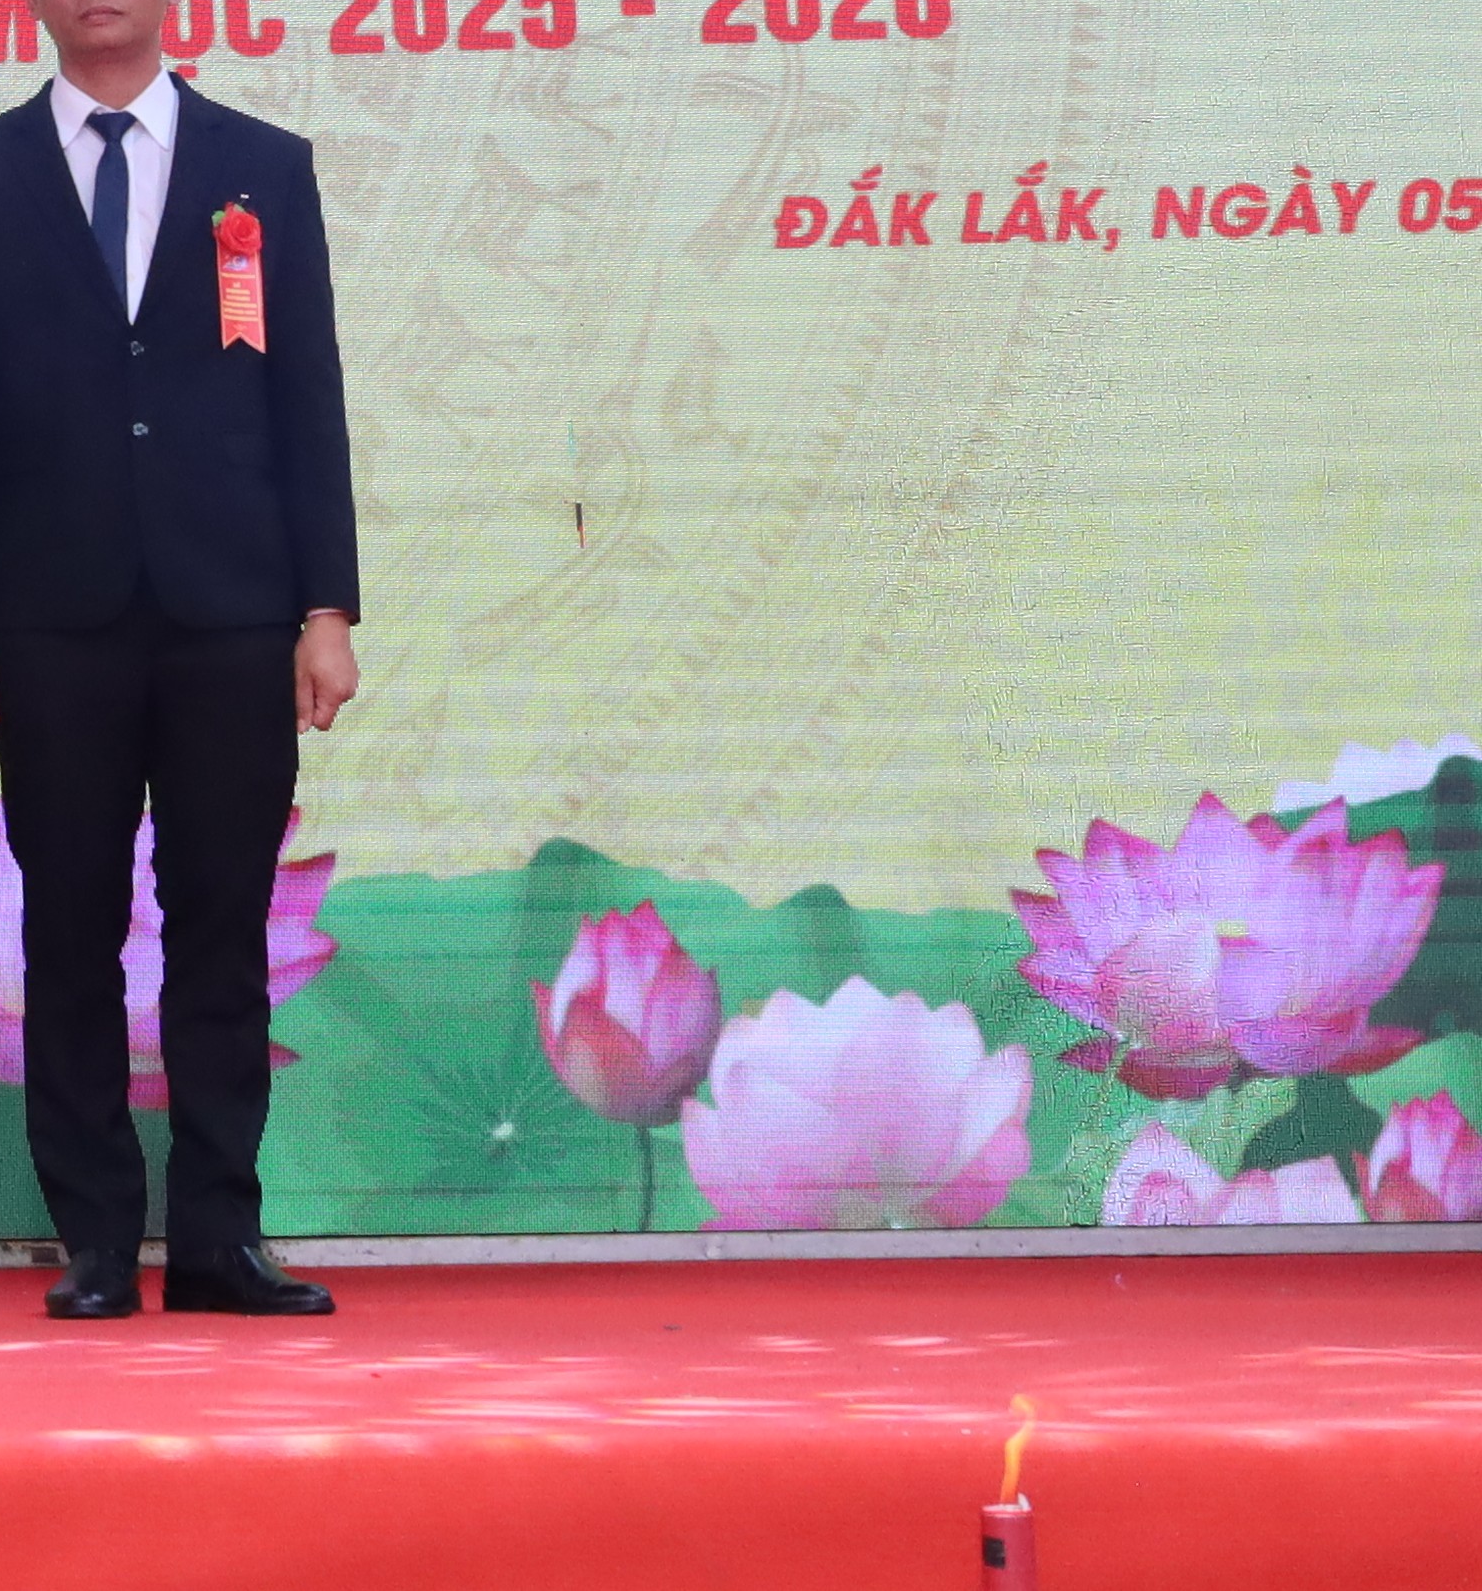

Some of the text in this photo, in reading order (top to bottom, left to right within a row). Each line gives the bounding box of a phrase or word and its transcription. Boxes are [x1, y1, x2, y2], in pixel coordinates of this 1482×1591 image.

[773, 166, 936, 249] ĐẮK
[960, 162, 1121, 253] LẮK,
[1151, 164, 1376, 240] NGÀY
